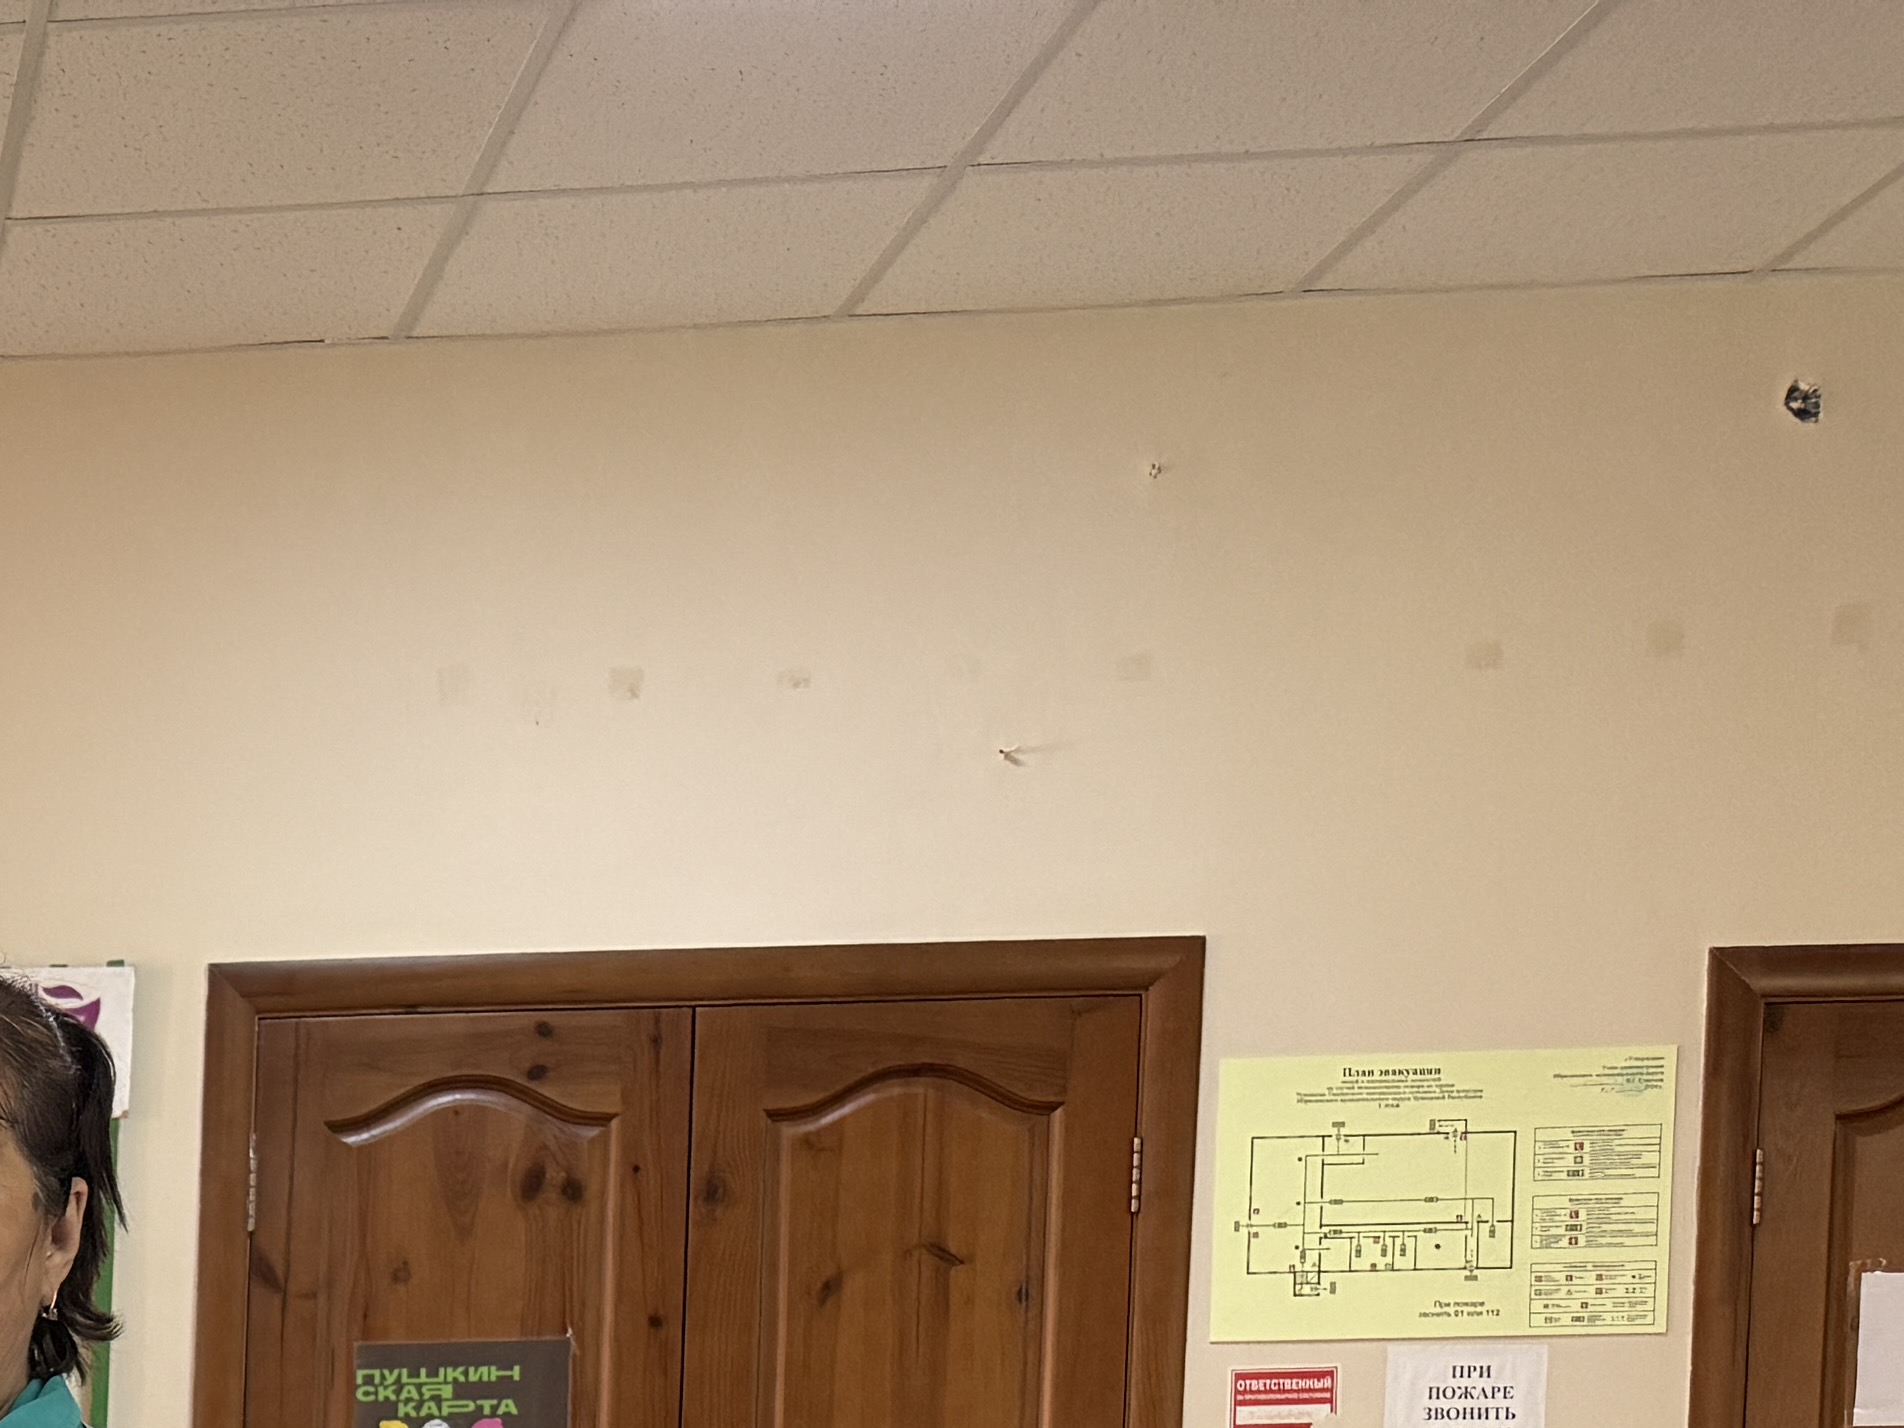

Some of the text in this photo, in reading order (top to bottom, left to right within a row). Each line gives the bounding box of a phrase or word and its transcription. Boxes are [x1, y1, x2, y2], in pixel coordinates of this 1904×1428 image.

[1454, 1309, 1464, 1318] 01
[1485, 1309, 1501, 1317] 112
[356, 1365, 520, 1385] ПУШКИН
[1451, 1365, 1492, 1378] ПРИ
[1237, 1376, 1332, 1392] ОТВЕТСТВЕННЫЙ
[356, 1384, 453, 1402] СКАЯ
[1427, 1386, 1515, 1400] ПОЖАРЕ
[397, 1399, 518, 1418] КАРТА
[1423, 1407, 1517, 1421] ЗВОНИТЬ
